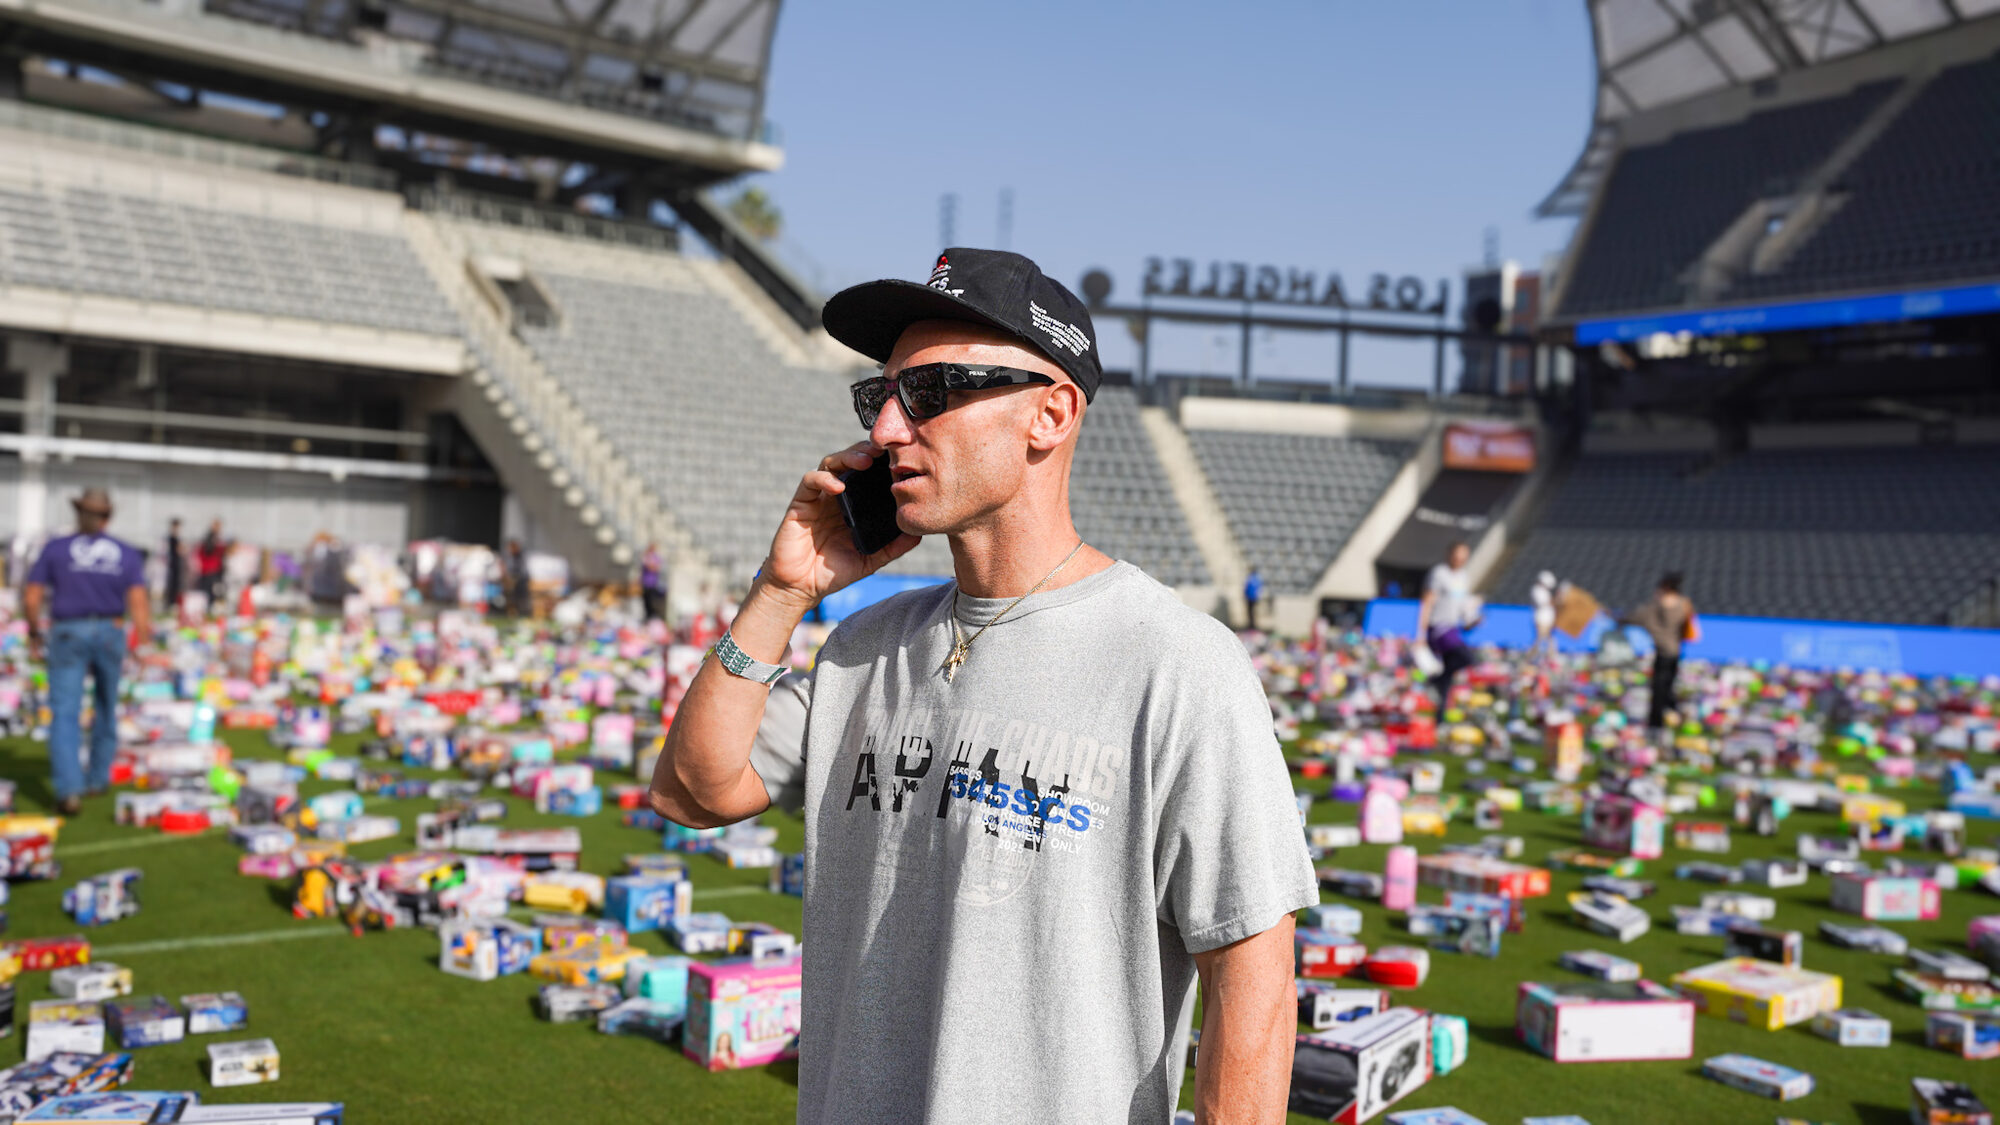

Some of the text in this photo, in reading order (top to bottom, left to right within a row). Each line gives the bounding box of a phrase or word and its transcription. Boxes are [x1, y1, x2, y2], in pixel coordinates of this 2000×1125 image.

[994, 720, 1124, 800] CHAOS
[951, 773, 1091, 832] 545SCS
[1038, 787, 1110, 816] SHOWROOM
[998, 840, 1024, 854] 2025
[1050, 837, 1082, 856] ONLY
